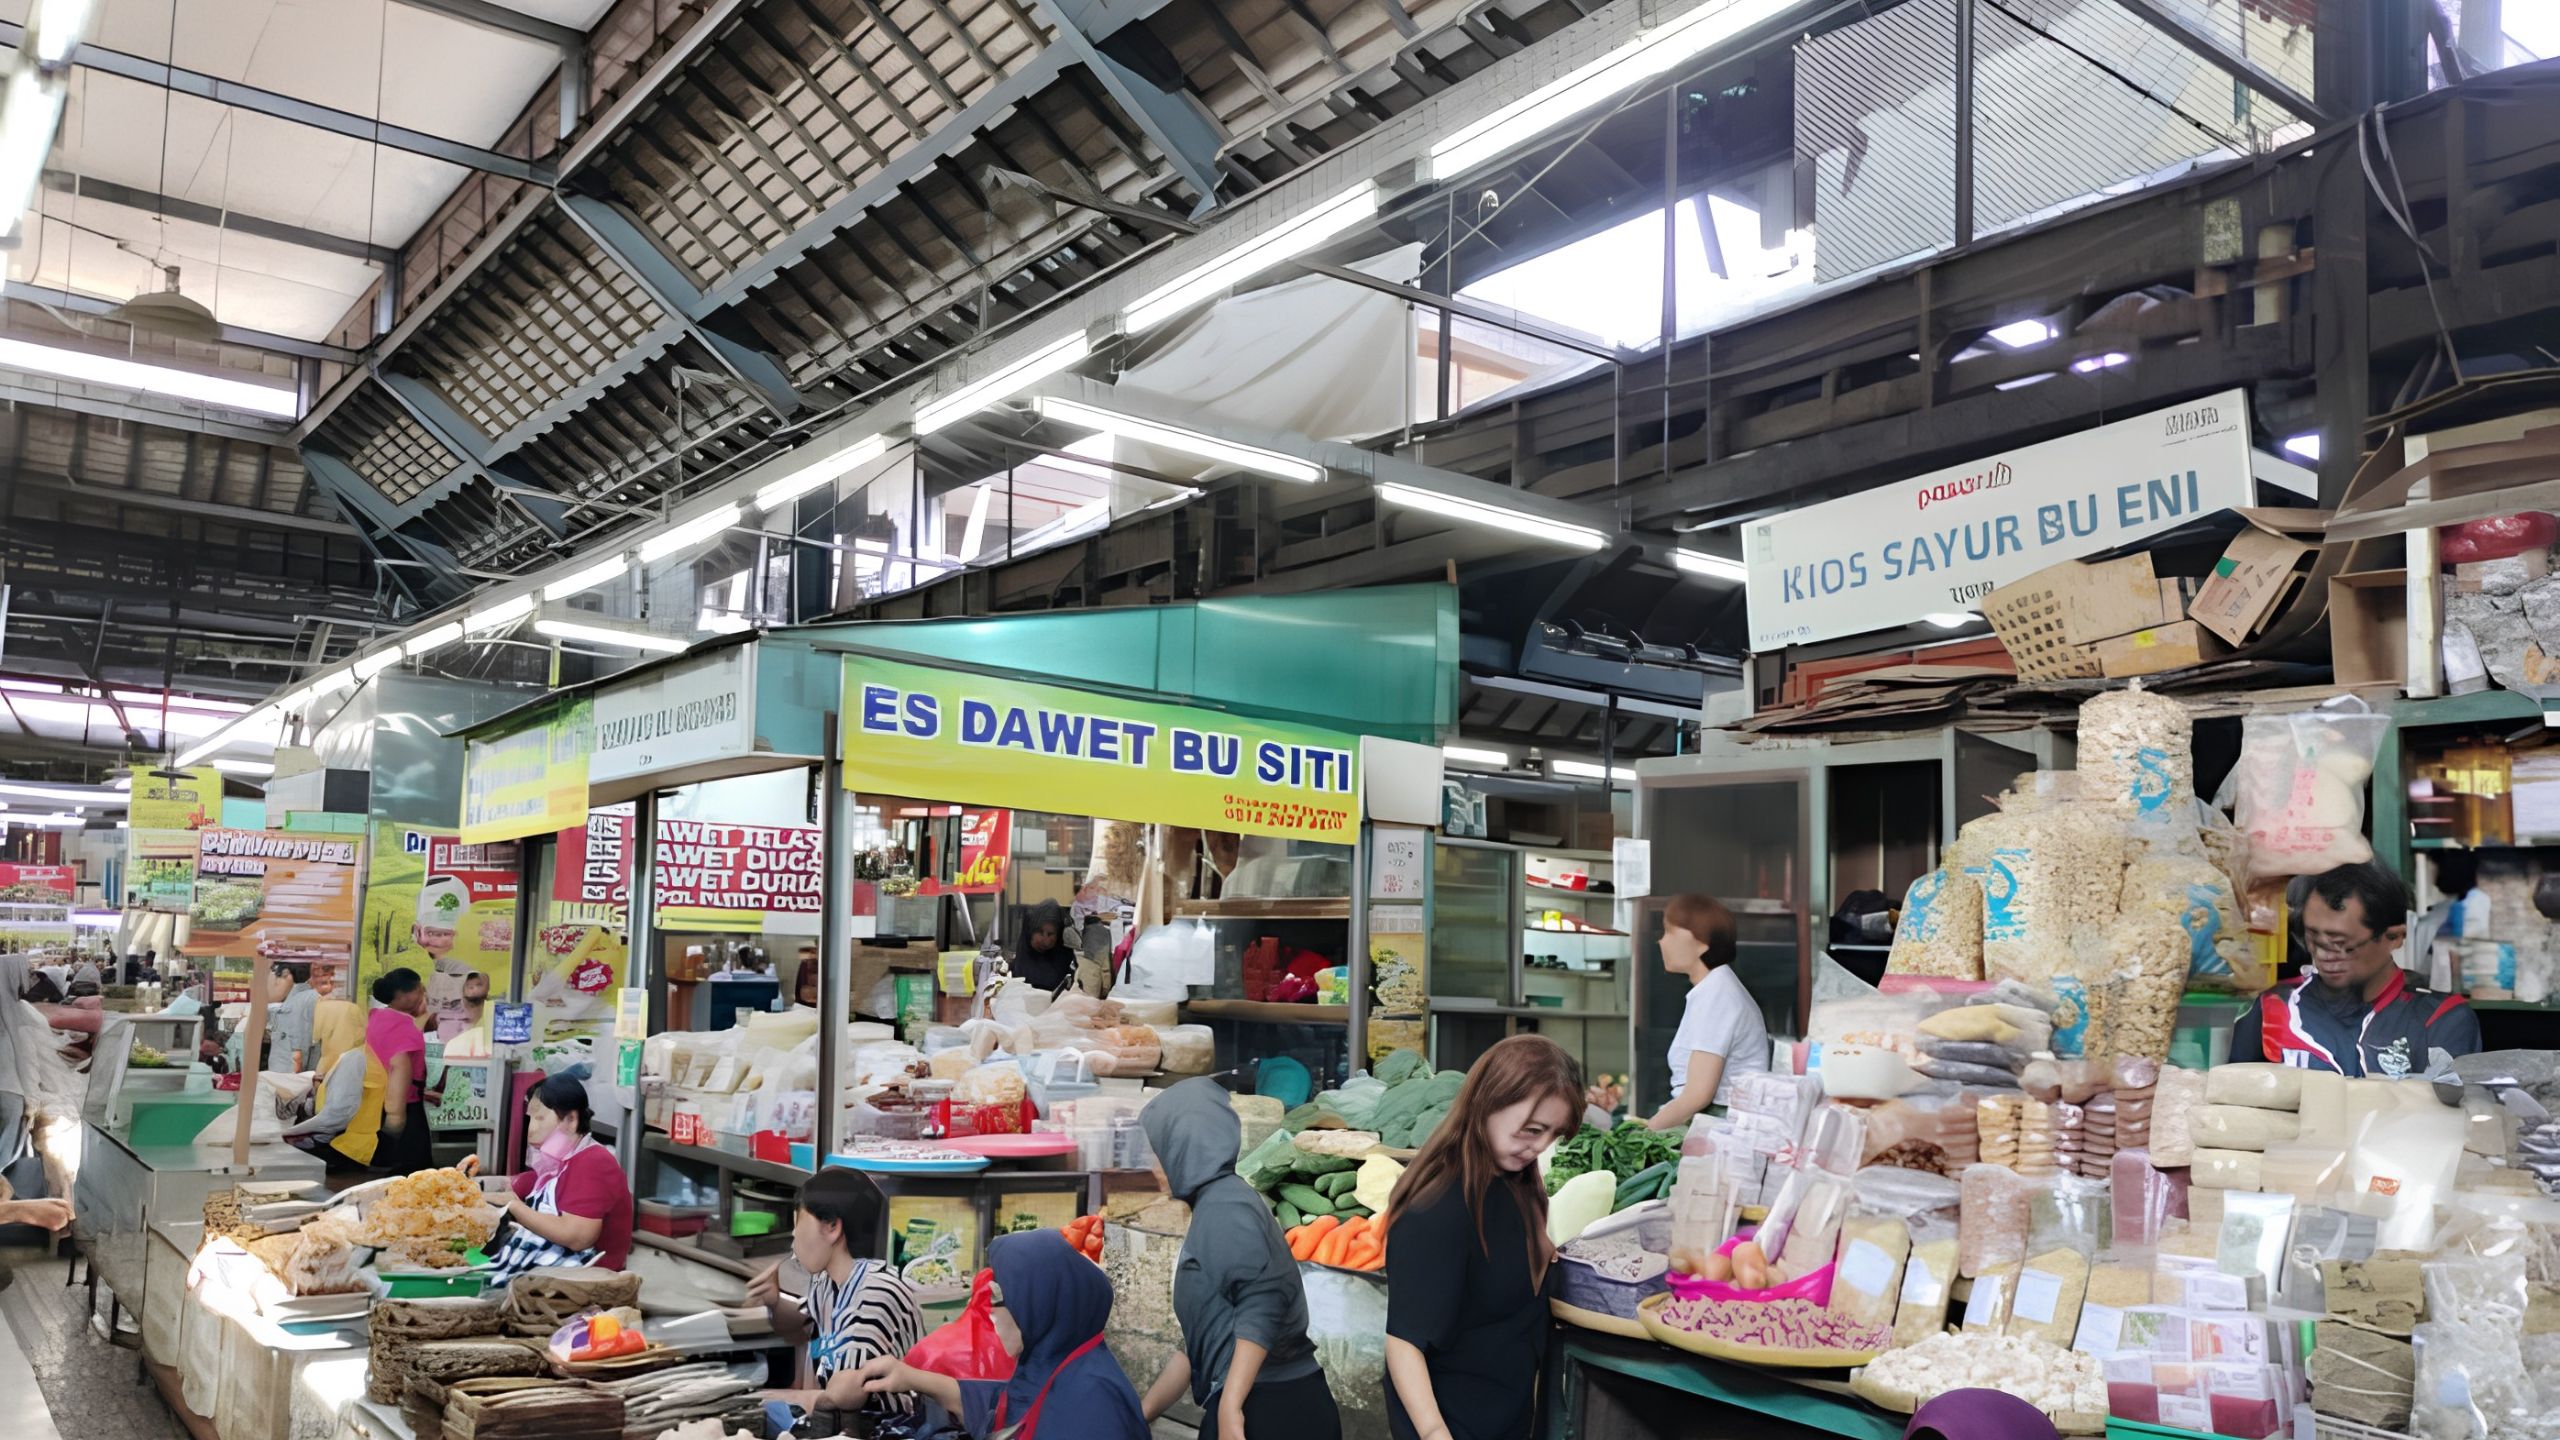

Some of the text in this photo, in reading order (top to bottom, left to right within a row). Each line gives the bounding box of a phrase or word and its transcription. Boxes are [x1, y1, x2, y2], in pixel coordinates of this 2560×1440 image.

[1783, 470, 2200, 604] KIOS SAYUR BU ENI
[862, 684, 1352, 792] ES DAWET BU SITI
